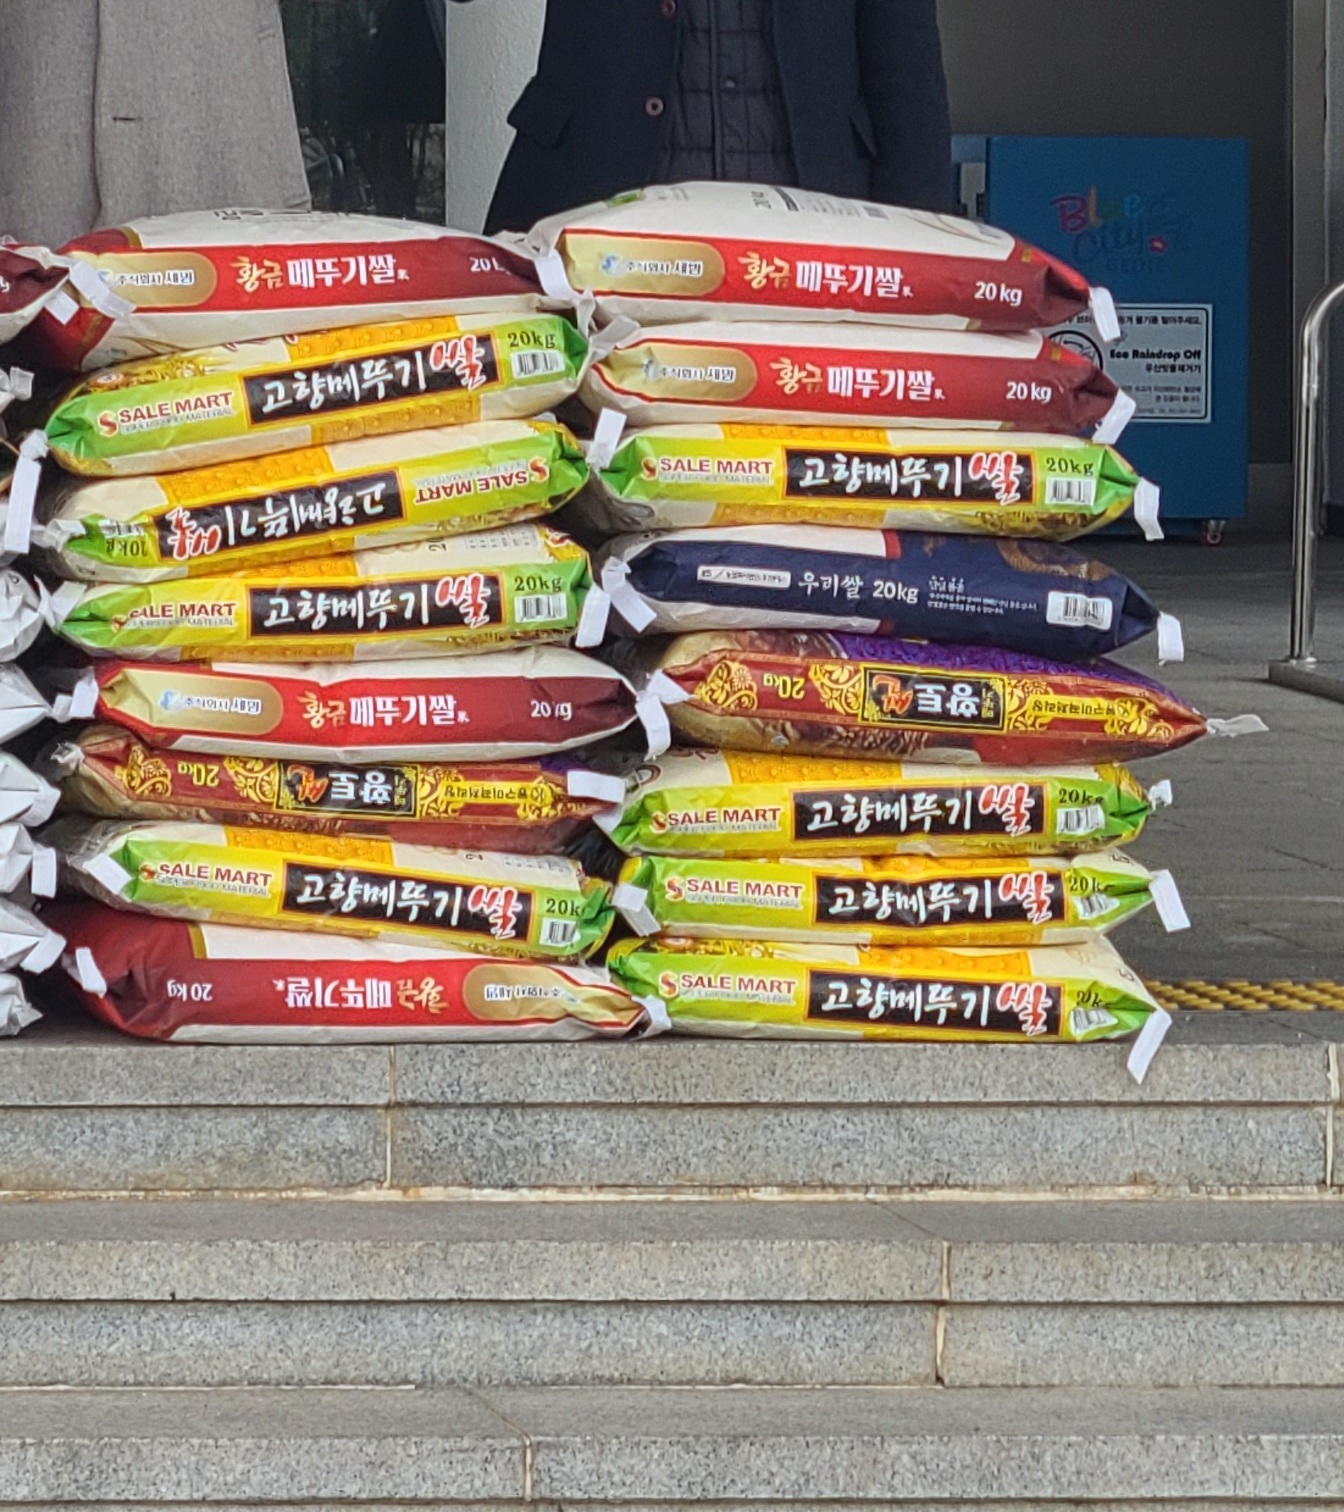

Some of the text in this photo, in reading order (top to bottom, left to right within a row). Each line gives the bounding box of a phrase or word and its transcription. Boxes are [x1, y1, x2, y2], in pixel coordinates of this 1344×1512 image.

[1050, 185, 1145, 232] Blue
[287, 254, 397, 287] 메뚜기쌀
[795, 261, 902, 298] 메뚜기쌀
[1110, 349, 1201, 361] Eco Raindrop Off
[262, 331, 557, 413] 고향메뚜기쌀 20kg
[827, 366, 933, 400] 메뚜기쌀
[119, 400, 170, 424] SALE
[174, 391, 233, 416] MART
[660, 458, 772, 475] SALE MART
[798, 451, 1093, 503] 고향메뚜기쌀 20kg
[415, 465, 527, 504] SALE MART
[167, 483, 386, 560] 고향메뚜기쌀
[264, 573, 563, 626] 고향메뚜기쌀 20kg
[798, 571, 862, 600] 우리쌀
[873, 580, 918, 604] 20kg
[177, 602, 237, 619] MART
[763, 672, 804, 699] 20kg
[350, 695, 457, 726] 메뚜기쌀
[669, 807, 781, 826] SALE MART
[806, 783, 1035, 838] 고향메뚜기쌀
[158, 863, 273, 885] SALE MART
[687, 878, 803, 898] SALE MART
[296, 873, 522, 940] 고향메뚜기쌀
[832, 872, 1054, 923] 고향메뚜기쌀
[286, 977, 392, 1009] 메뚜기쌀
[681, 973, 796, 995] SALE MART
[820, 983, 1051, 1034] 고향메뚜기쌀
